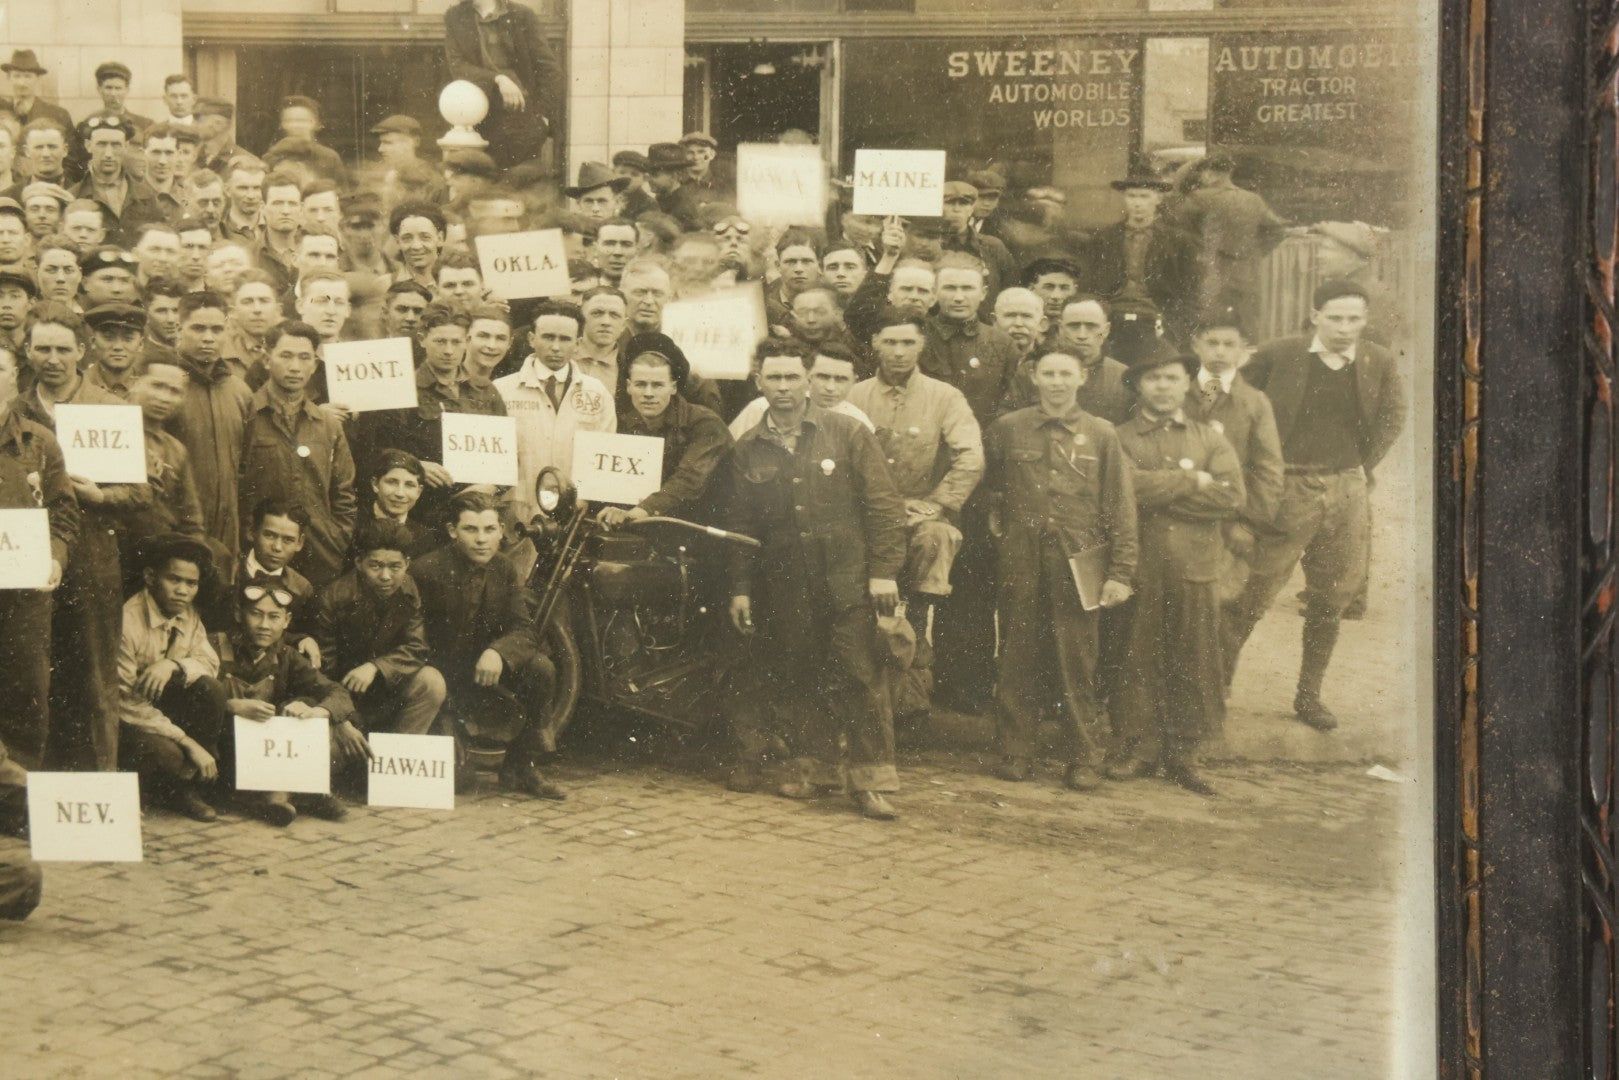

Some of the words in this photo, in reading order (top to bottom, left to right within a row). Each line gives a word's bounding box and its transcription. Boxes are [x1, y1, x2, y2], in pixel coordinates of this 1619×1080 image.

[948, 49, 1138, 78] SWEENEY
[988, 82, 1131, 104] AUTOMOBILE
[1259, 76, 1356, 97] TRACTOR
[1033, 108, 1131, 128] WORLDS
[1256, 102, 1358, 123] GREATEST
[858, 170, 937, 188] MAINE.
[493, 254, 558, 274] OKLA.
[335, 360, 404, 382] MONT.
[72, 429, 130, 449] ARIZ.
[448, 434, 509, 456] S.DAK.
[594, 453, 645, 476] TEX.
[371, 756, 446, 779] HAWAII
[55, 801, 115, 824] NEV.
